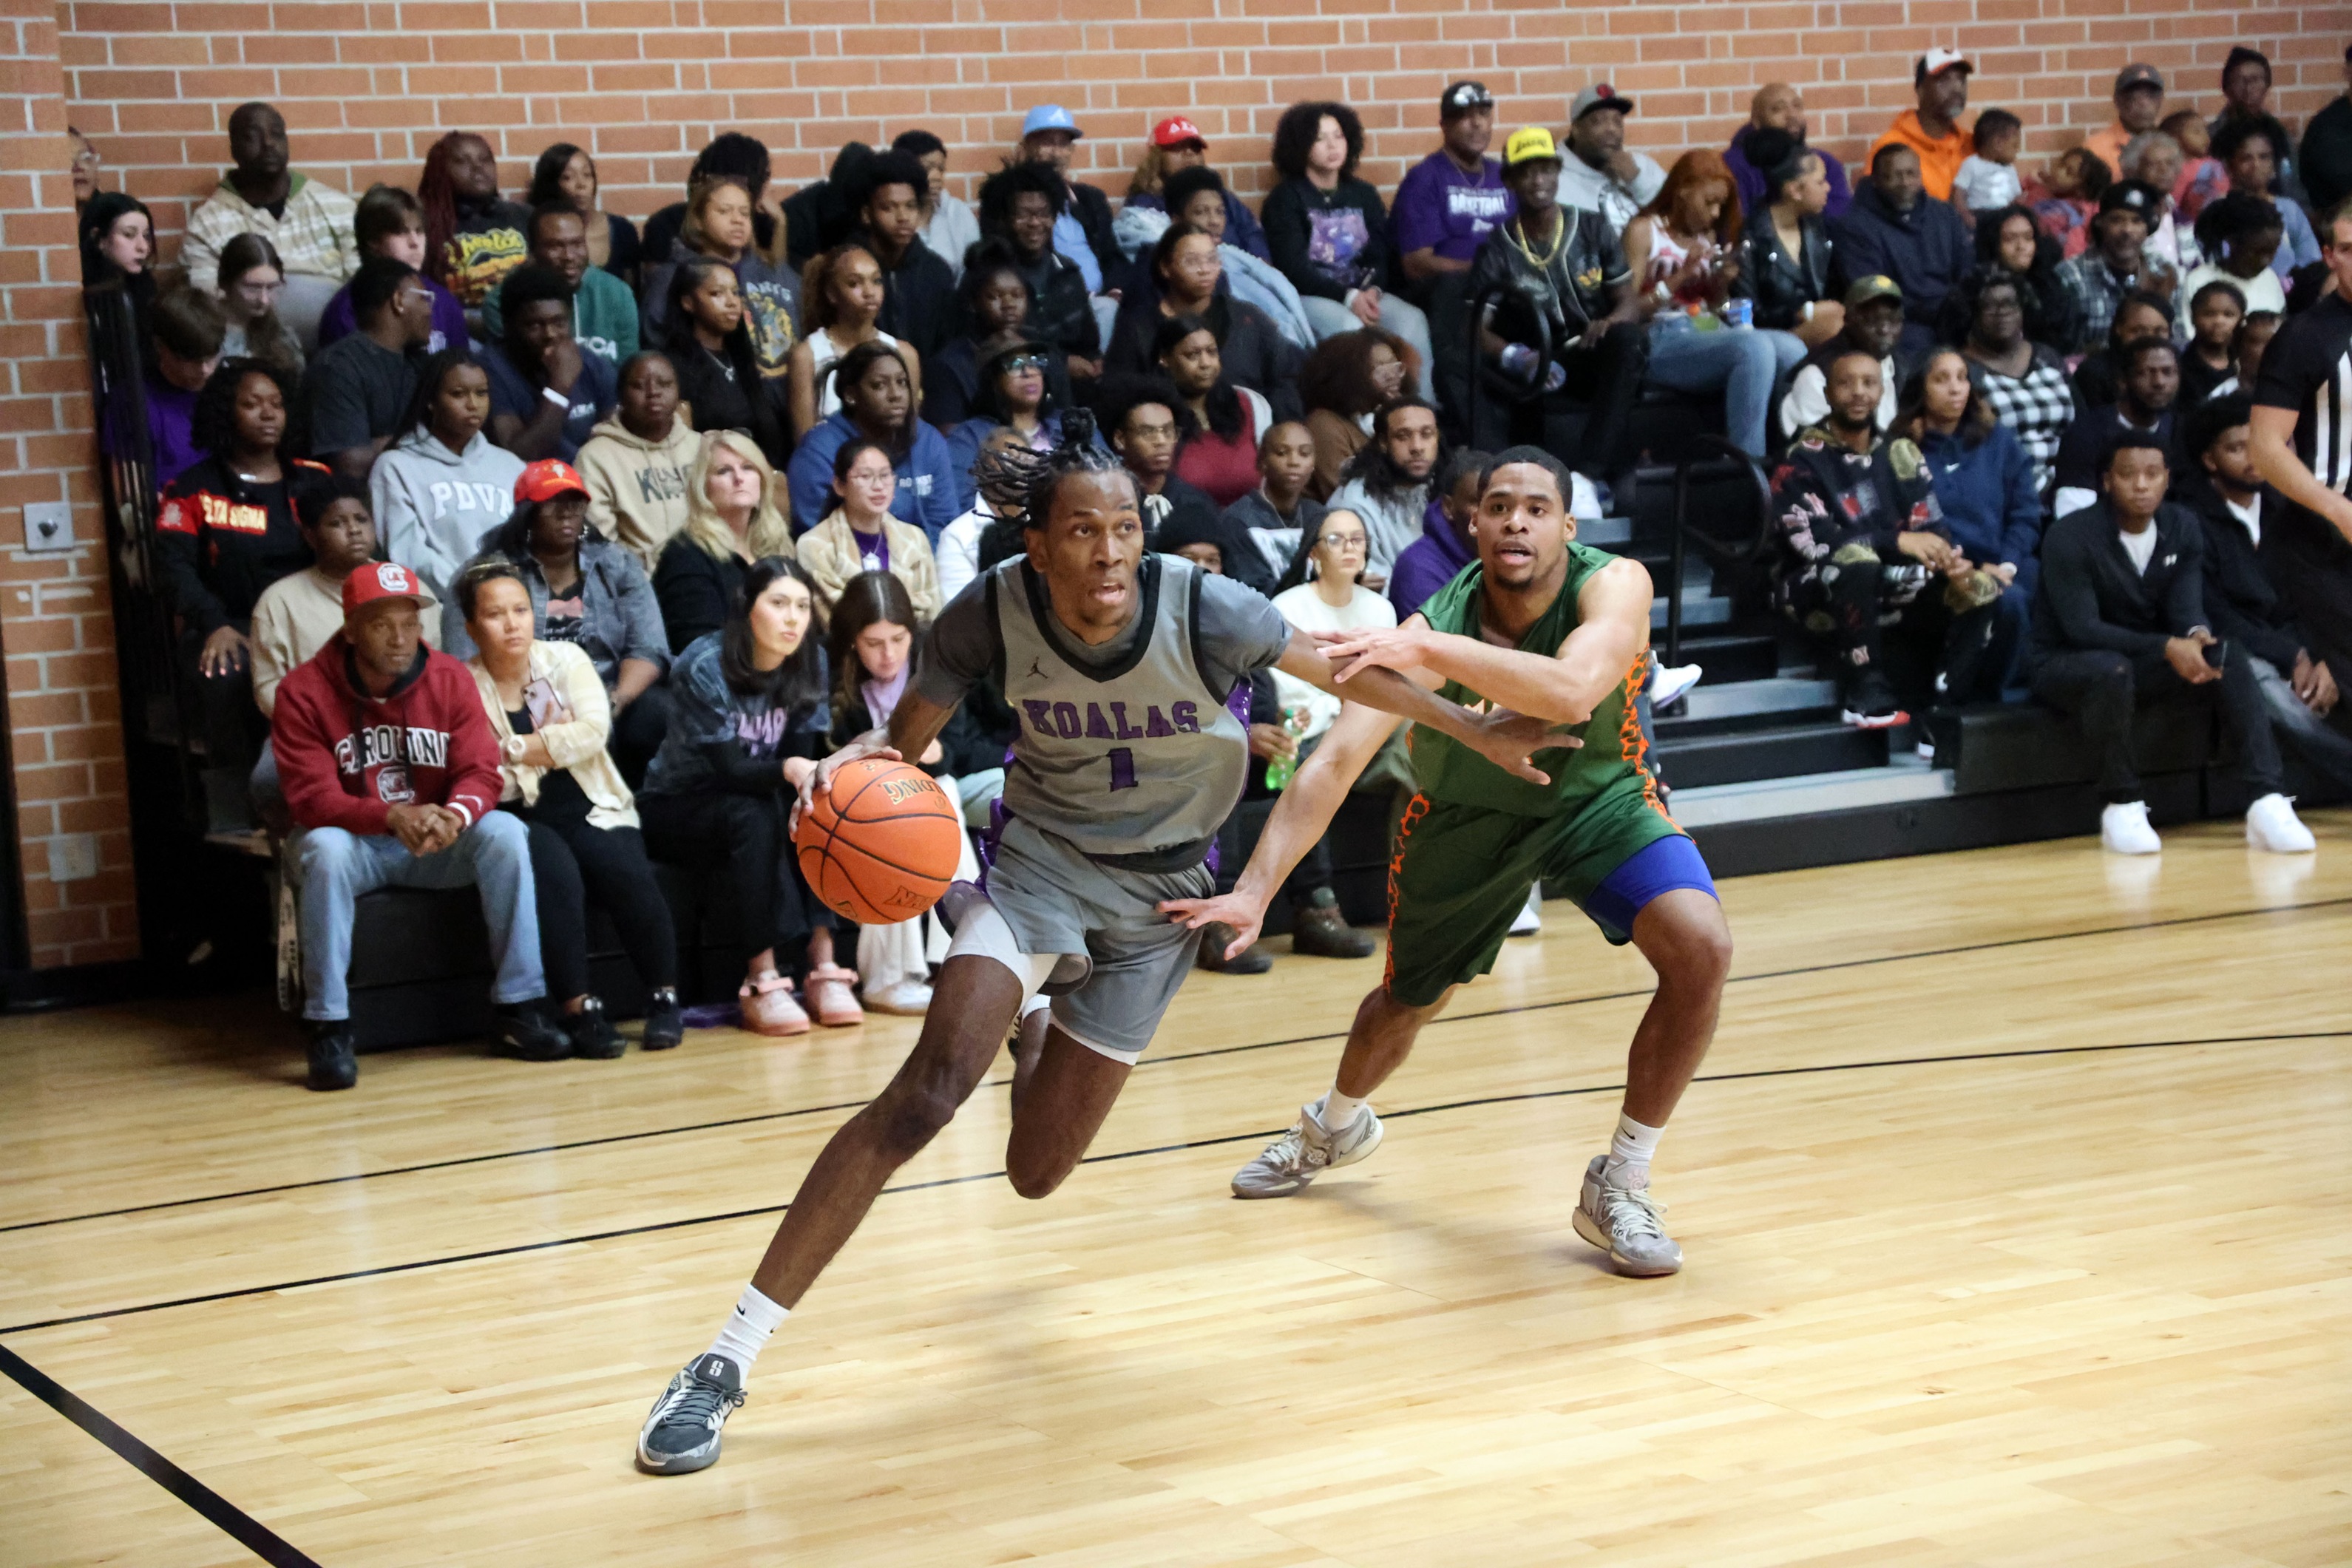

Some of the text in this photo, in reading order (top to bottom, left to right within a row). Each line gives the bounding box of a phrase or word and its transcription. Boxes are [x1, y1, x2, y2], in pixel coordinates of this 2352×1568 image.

[1022, 699, 1201, 740] KOALAS
[1107, 747, 1139, 793] 1
[882, 778, 946, 805] LDING
